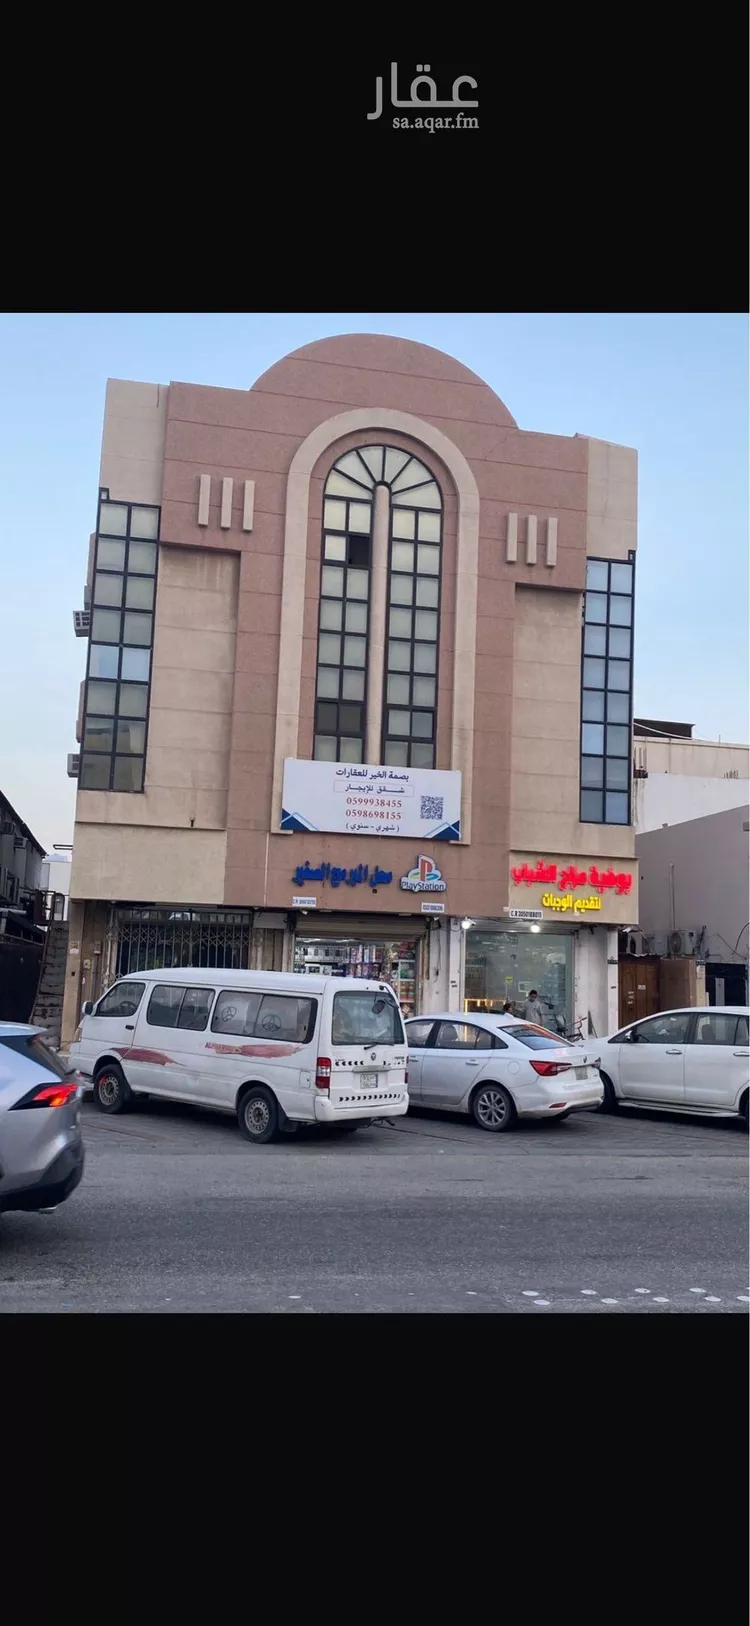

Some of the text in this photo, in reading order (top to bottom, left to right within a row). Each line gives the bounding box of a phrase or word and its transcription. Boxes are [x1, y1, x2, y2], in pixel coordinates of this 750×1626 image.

[335, 767, 410, 781] بصمة الخير للعقارات
[376, 785, 405, 794] شقق
[346, 796, 402, 808] 0599938455
[345, 808, 402, 820] 0598698155
[512, 860, 557, 886] الشباب
[401, 881, 445, 892] PlayStation
[542, 893, 602, 913] لتقديم الوجبات
